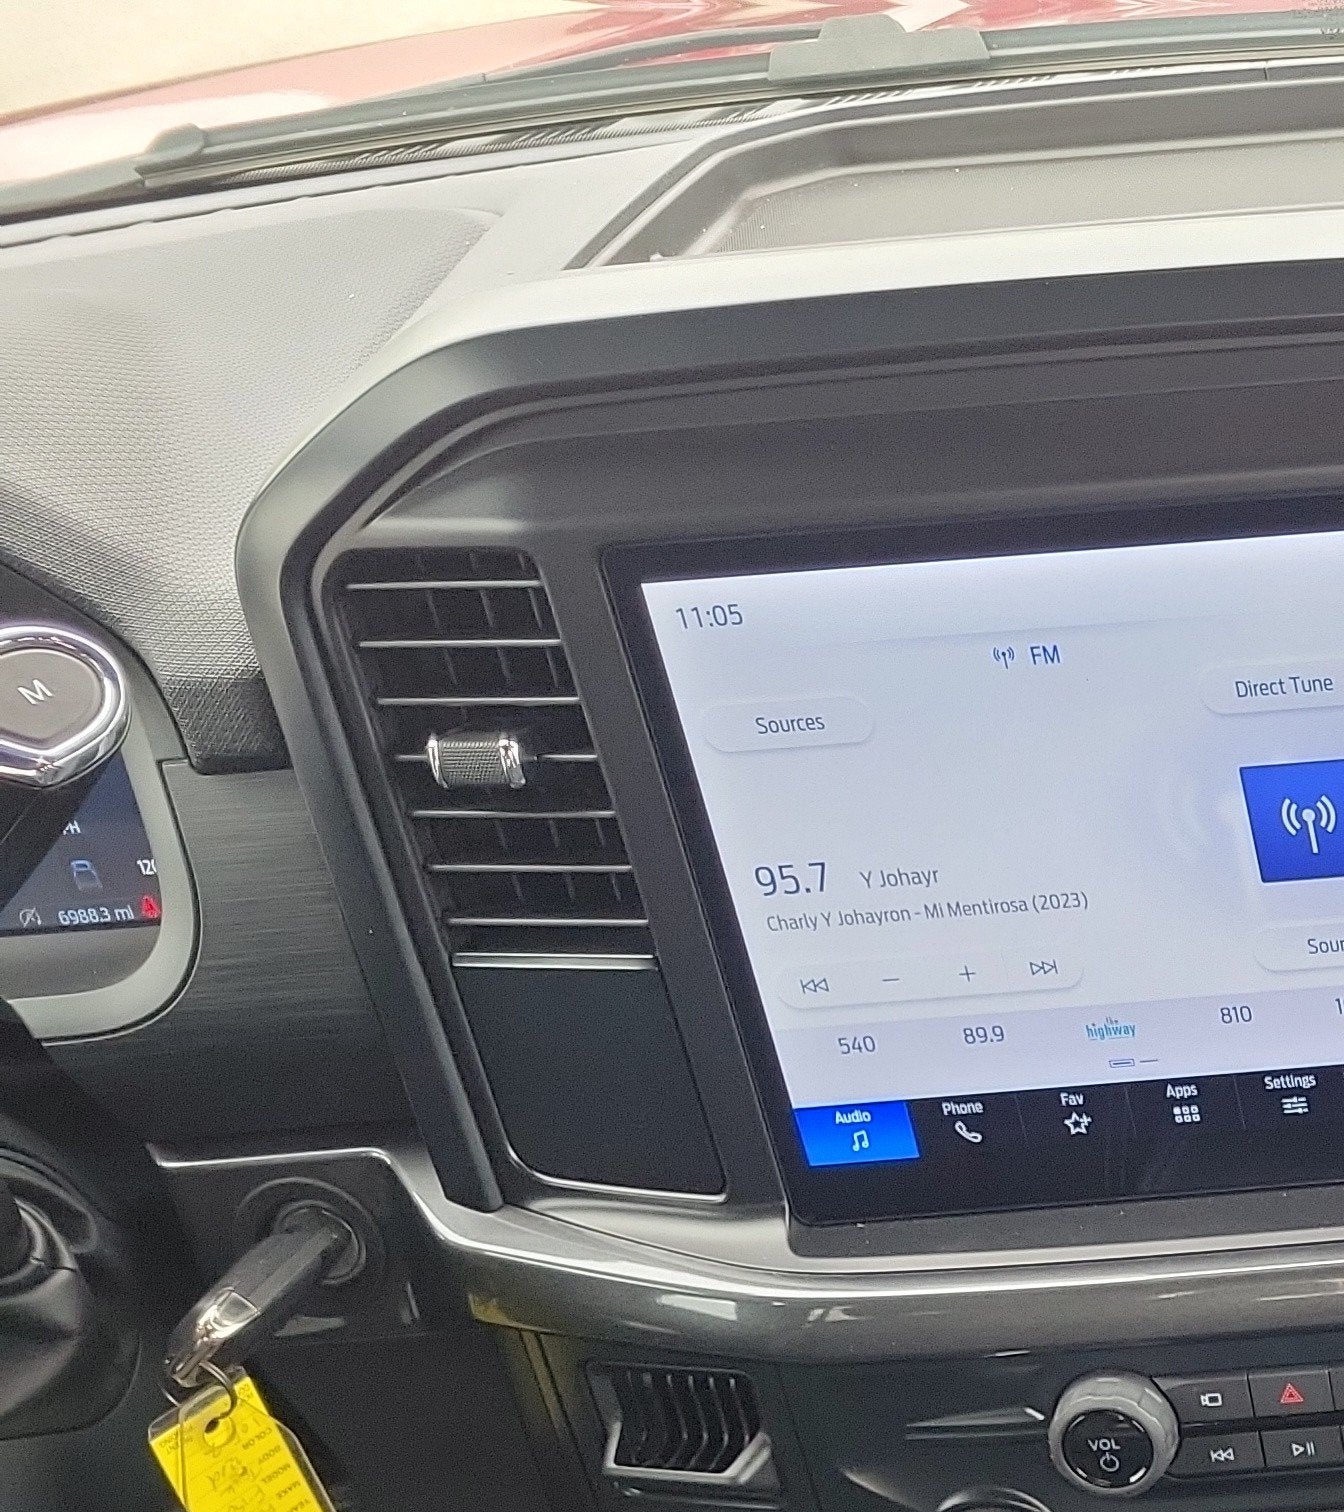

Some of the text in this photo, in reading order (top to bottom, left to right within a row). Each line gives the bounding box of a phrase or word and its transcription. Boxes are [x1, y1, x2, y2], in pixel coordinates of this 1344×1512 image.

[675, 603, 744, 631] 11:05
[1029, 644, 1062, 666] FM
[17, 678, 54, 706] M
[1234, 673, 1334, 699] Direct Tune
[754, 713, 826, 737] Sources
[753, 860, 940, 898] 95.7 Y Johayr
[766, 890, 1090, 936] Charly Y Johayron Mi Mentirosa (2023)
[1219, 1005, 1253, 1025] 810
[962, 1025, 1006, 1045] 89.9
[1084, 1022, 1136, 1041] highway
[837, 1034, 877, 1056] 540
[1165, 1083, 1199, 1101] Apps
[1263, 1071, 1318, 1091] Settings
[941, 1099, 985, 1117] Phone
[1059, 1091, 1085, 1108] Fav
[834, 1108, 873, 1125] Audio
[241, 1427, 273, 1450] COLOR
[1087, 1437, 1122, 1453] VOL
[257, 1444, 282, 1466] BODY
[261, 1463, 292, 1485] MODEL
[276, 1480, 302, 1501] MAKE
